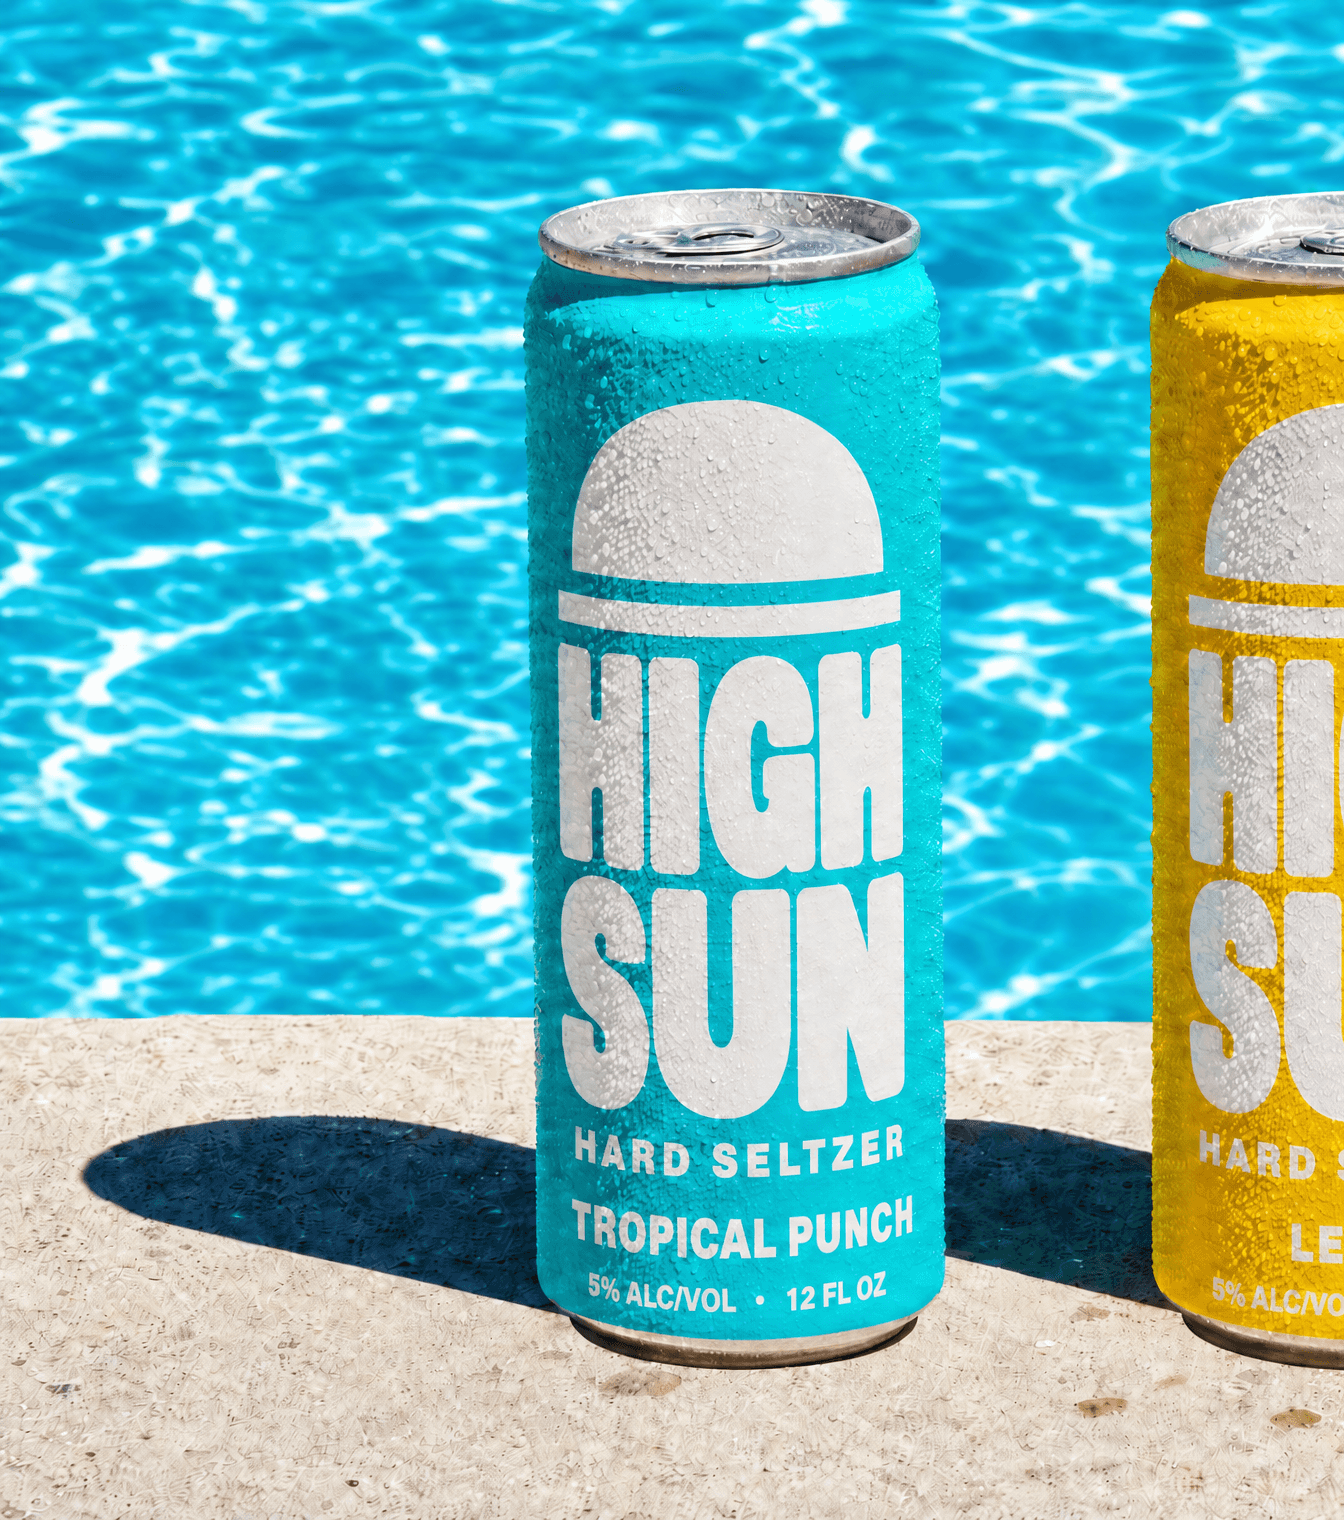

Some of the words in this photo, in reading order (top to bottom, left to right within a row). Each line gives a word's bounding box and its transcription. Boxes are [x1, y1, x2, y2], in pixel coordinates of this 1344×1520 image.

[558, 642, 904, 880] HIGH
[560, 871, 905, 1120] SUN
[574, 1126, 690, 1177] HARD
[712, 1124, 903, 1179] SELTZER
[1199, 1129, 1316, 1180] HARD
[571, 1198, 777, 1260] TROPICAL
[789, 1195, 913, 1257] PUNCH
[588, 1273, 620, 1304] 5%
[626, 1281, 737, 1313] ALC/VOL
[787, 1287, 816, 1312] 12
[823, 1281, 851, 1307] FL
[857, 1270, 887, 1301] OZ
[1212, 1276, 1246, 1307] 5%
